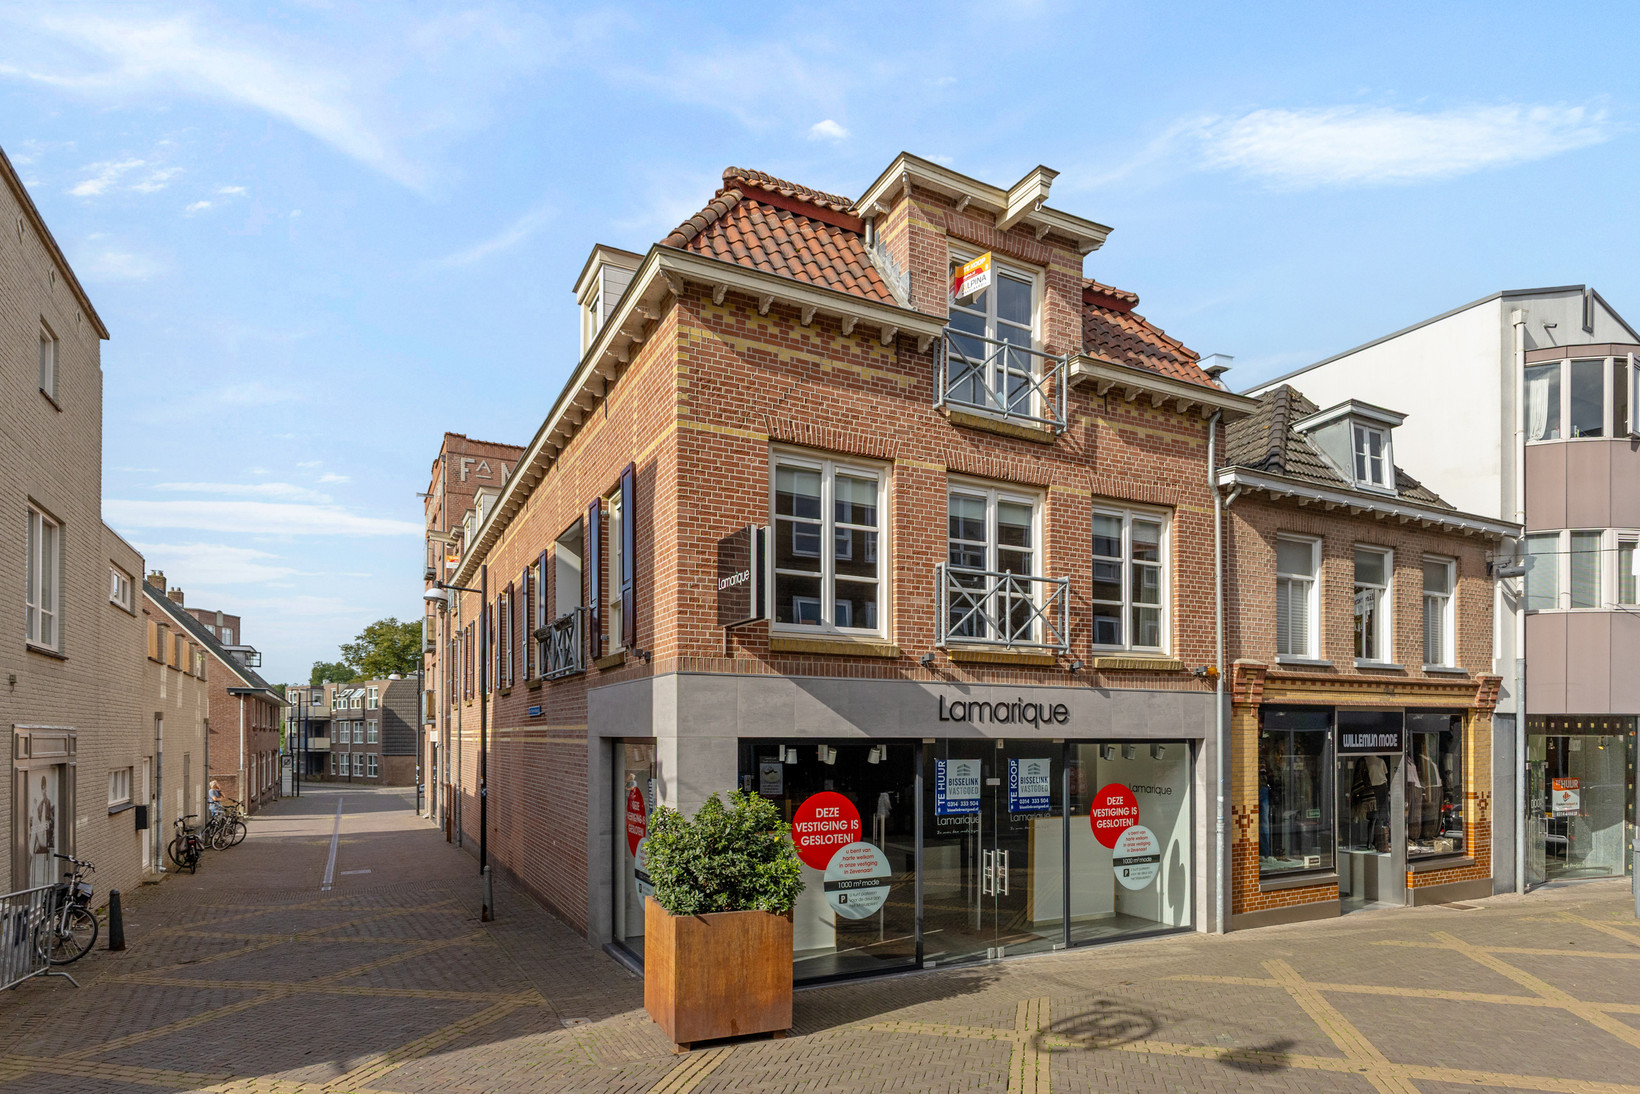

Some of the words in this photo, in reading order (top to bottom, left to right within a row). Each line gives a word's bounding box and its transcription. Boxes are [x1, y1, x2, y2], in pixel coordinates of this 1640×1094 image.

[970, 257, 986, 269] KOOP
[718, 569, 750, 591] Lamarique
[939, 694, 1069, 729] Lamarique
[1378, 733, 1398, 747] MODE
[938, 761, 946, 791] HUUR
[948, 777, 979, 787] BISSELINK
[1020, 776, 1049, 784] BISSELINK
[1020, 784, 1049, 793] VASTGOED
[1129, 783, 1173, 796] Lamarique
[1561, 779, 1579, 789] HUUR
[948, 786, 979, 796] VASTGOED
[938, 793, 946, 806] TE
[1011, 792, 1018, 804] TE
[1106, 796, 1124, 805] DEZE
[815, 807, 840, 818] DEZE
[1092, 807, 1130, 817] VESTIGING
[1131, 807, 1138, 815] IS
[795, 820, 848, 833] VESTIGING
[850, 819, 859, 830] IS
[937, 815, 980, 827] Lamarique
[1096, 818, 1134, 828] GESLOTEN!
[800, 833, 854, 846] GESLOTEN!
[862, 879, 880, 887] mode
